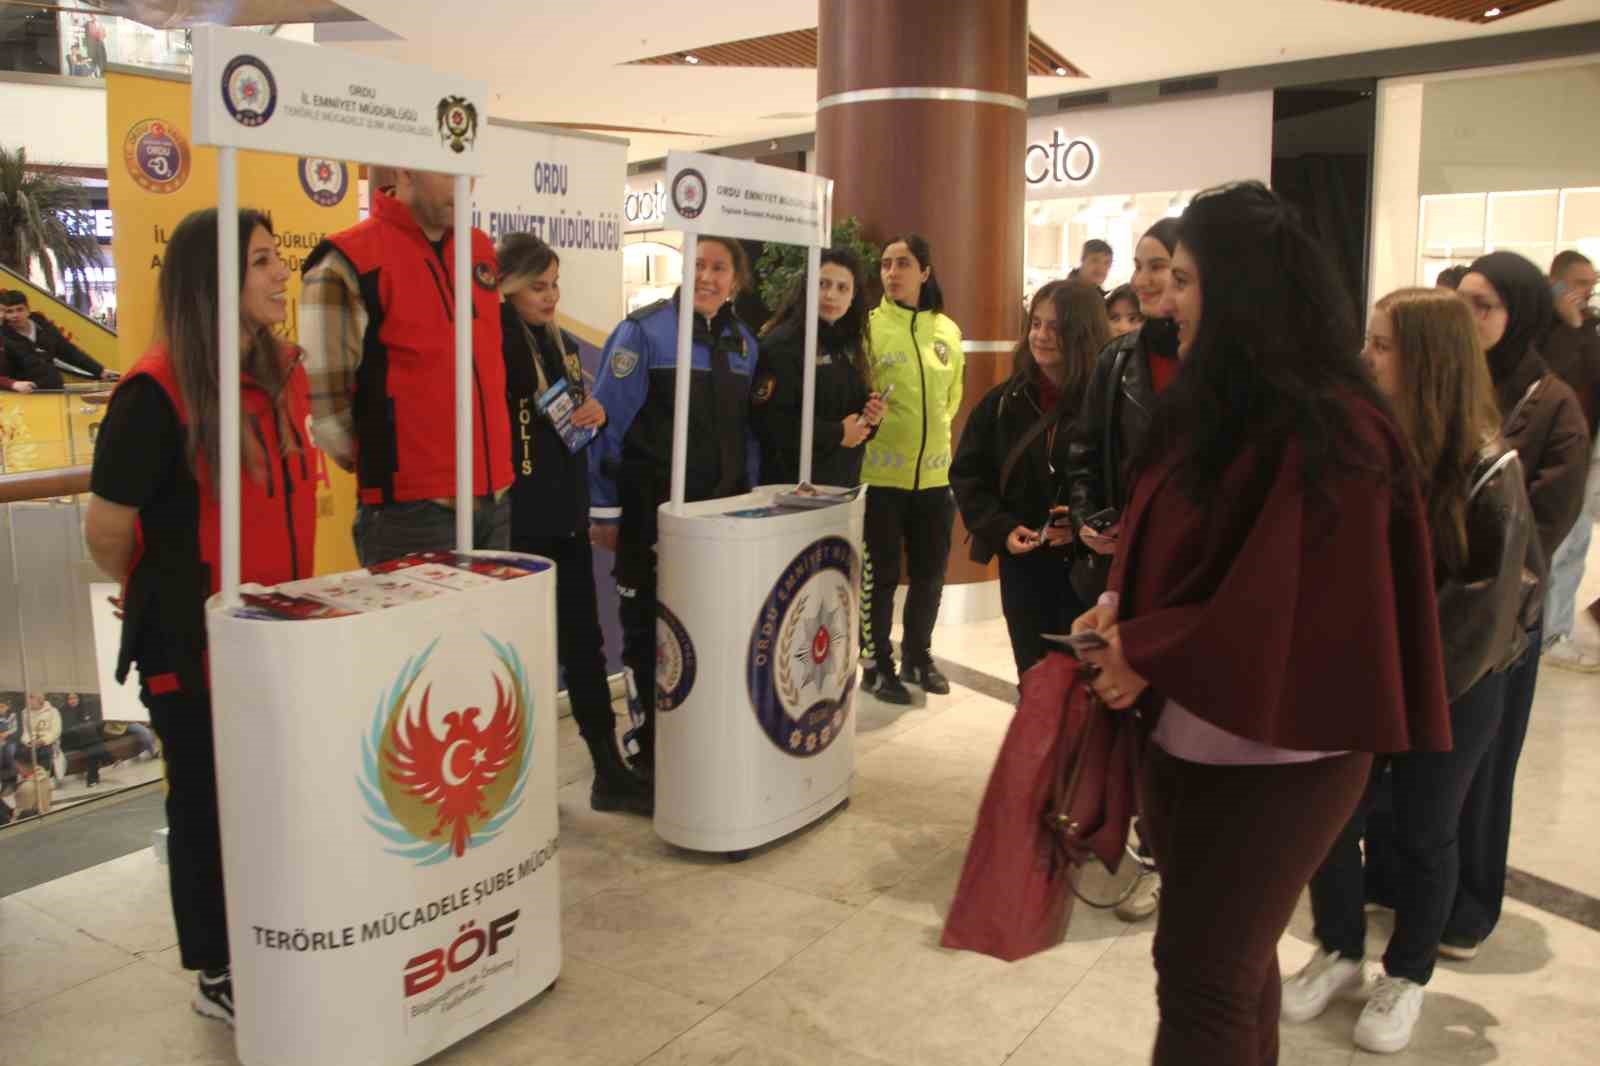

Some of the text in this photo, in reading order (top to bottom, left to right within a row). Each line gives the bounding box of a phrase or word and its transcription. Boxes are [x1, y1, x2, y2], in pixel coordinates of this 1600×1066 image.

[348, 83, 376, 99] ORDU
[534, 161, 568, 196] ORDU
[1026, 130, 1094, 184] cto
[549, 209, 620, 251] MÜDÜRLÜĞÜ
[252, 925, 355, 951] TERÖRLE
[361, 886, 470, 944] MÜCADELE
[474, 866, 516, 905] ŞUBE
[403, 908, 521, 998] BÖF
